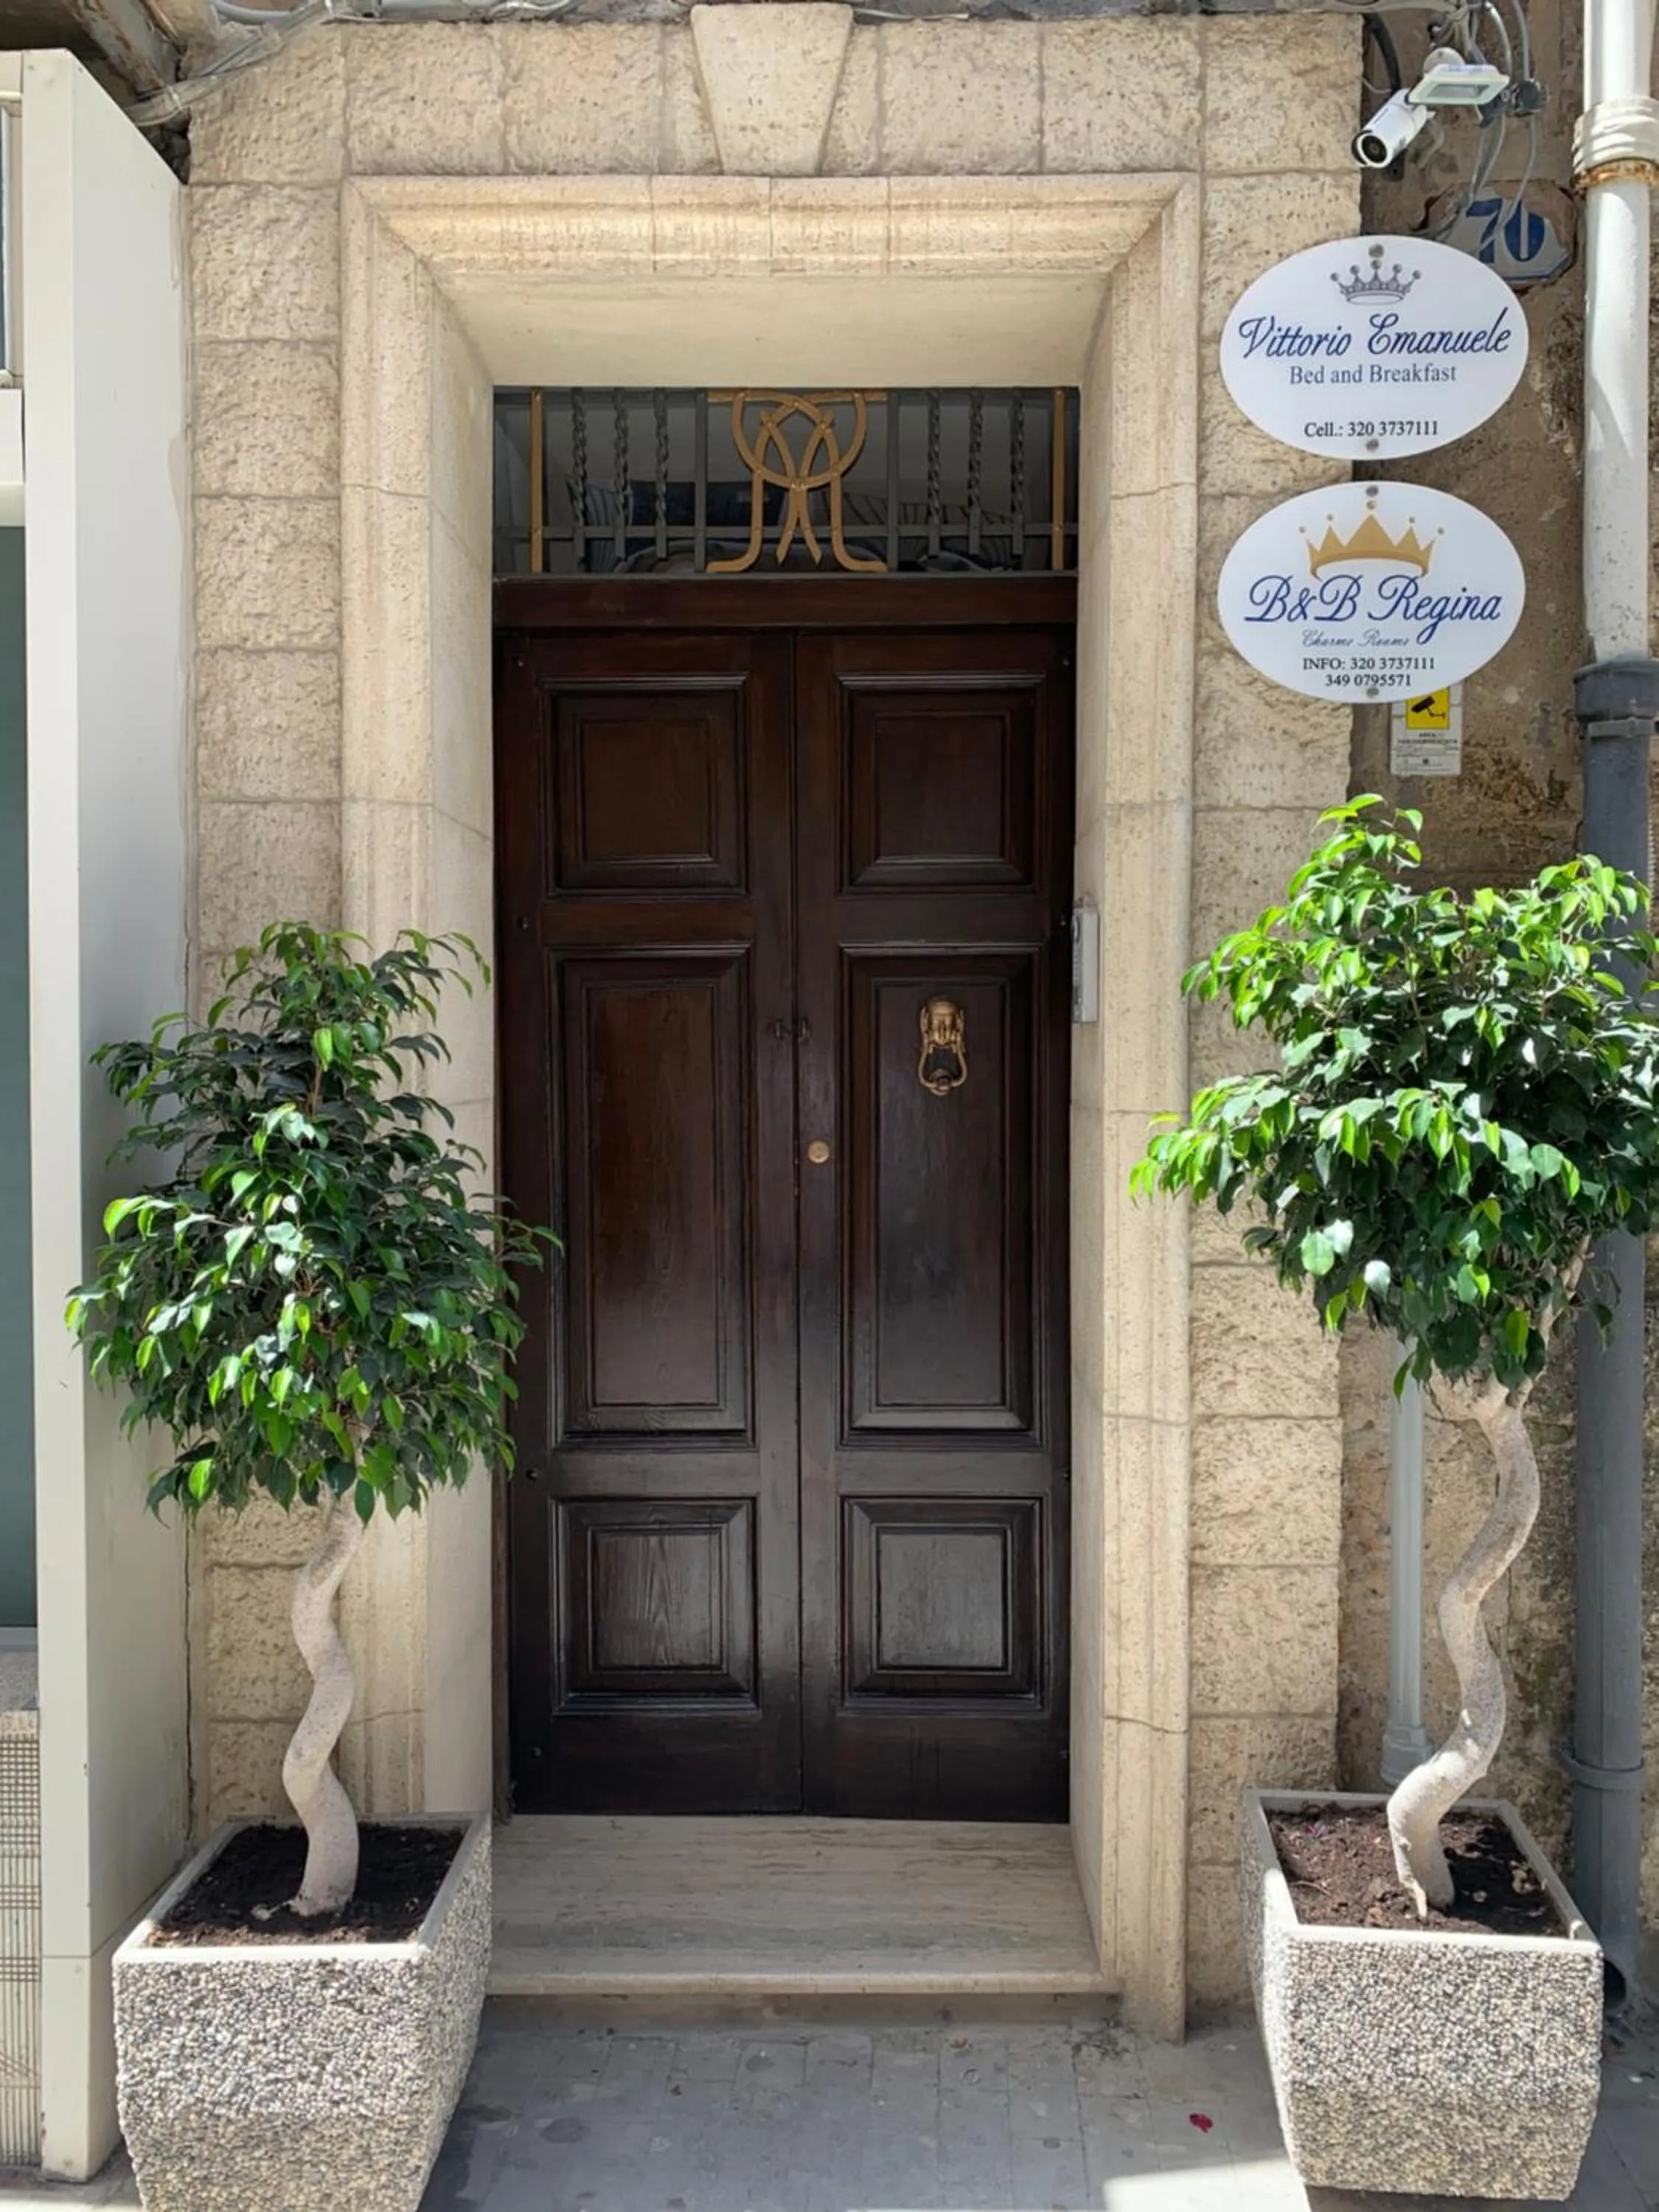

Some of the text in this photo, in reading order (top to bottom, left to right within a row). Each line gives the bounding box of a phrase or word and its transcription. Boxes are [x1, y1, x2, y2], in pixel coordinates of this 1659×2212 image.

[1466, 197, 1545, 263] 70
[1238, 306, 1512, 359] Vittorio Emanuele
[1290, 363, 1457, 385] Bed and Breakfast
[1304, 420, 1439, 438] Cell.: 320 3737111
[1244, 574, 1503, 645] B&B Regina
[1302, 656, 1435, 670] INFO: 320 3737111
[1324, 672, 1412, 687] 349 0795571
